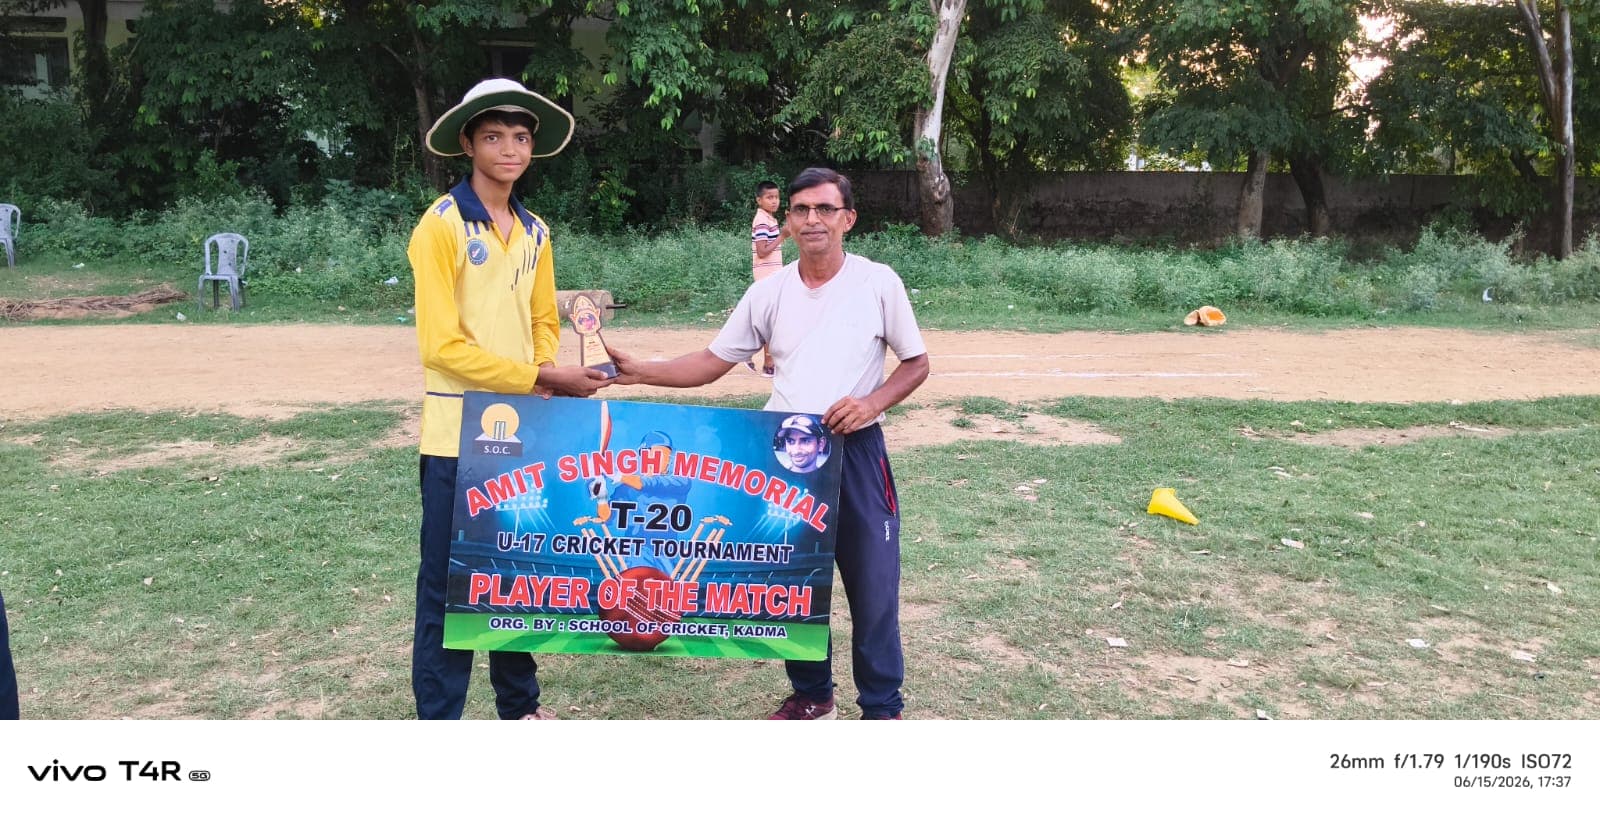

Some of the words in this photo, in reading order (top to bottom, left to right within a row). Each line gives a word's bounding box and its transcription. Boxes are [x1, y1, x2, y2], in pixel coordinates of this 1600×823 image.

[466, 462, 545, 517] AMIT
[558, 449, 662, 483] SINGH
[673, 451, 829, 532] MEMORIAL
[609, 501, 693, 532] T-20
[498, 531, 547, 553] U-17
[552, 534, 645, 557] CRICKET
[651, 539, 795, 563] TOURNAMENT
[469, 573, 590, 609] PLAYER
[598, 577, 637, 610] OF
[643, 579, 699, 613] THE
[705, 582, 812, 616] MATCH
[489, 617, 528, 631] ORG.
[533, 618, 556, 631] BY
[568, 620, 632, 633] SCHOOL
[637, 622, 657, 634] OF
[661, 623, 729, 638] CRICKET,
[733, 625, 787, 638] KADMA
